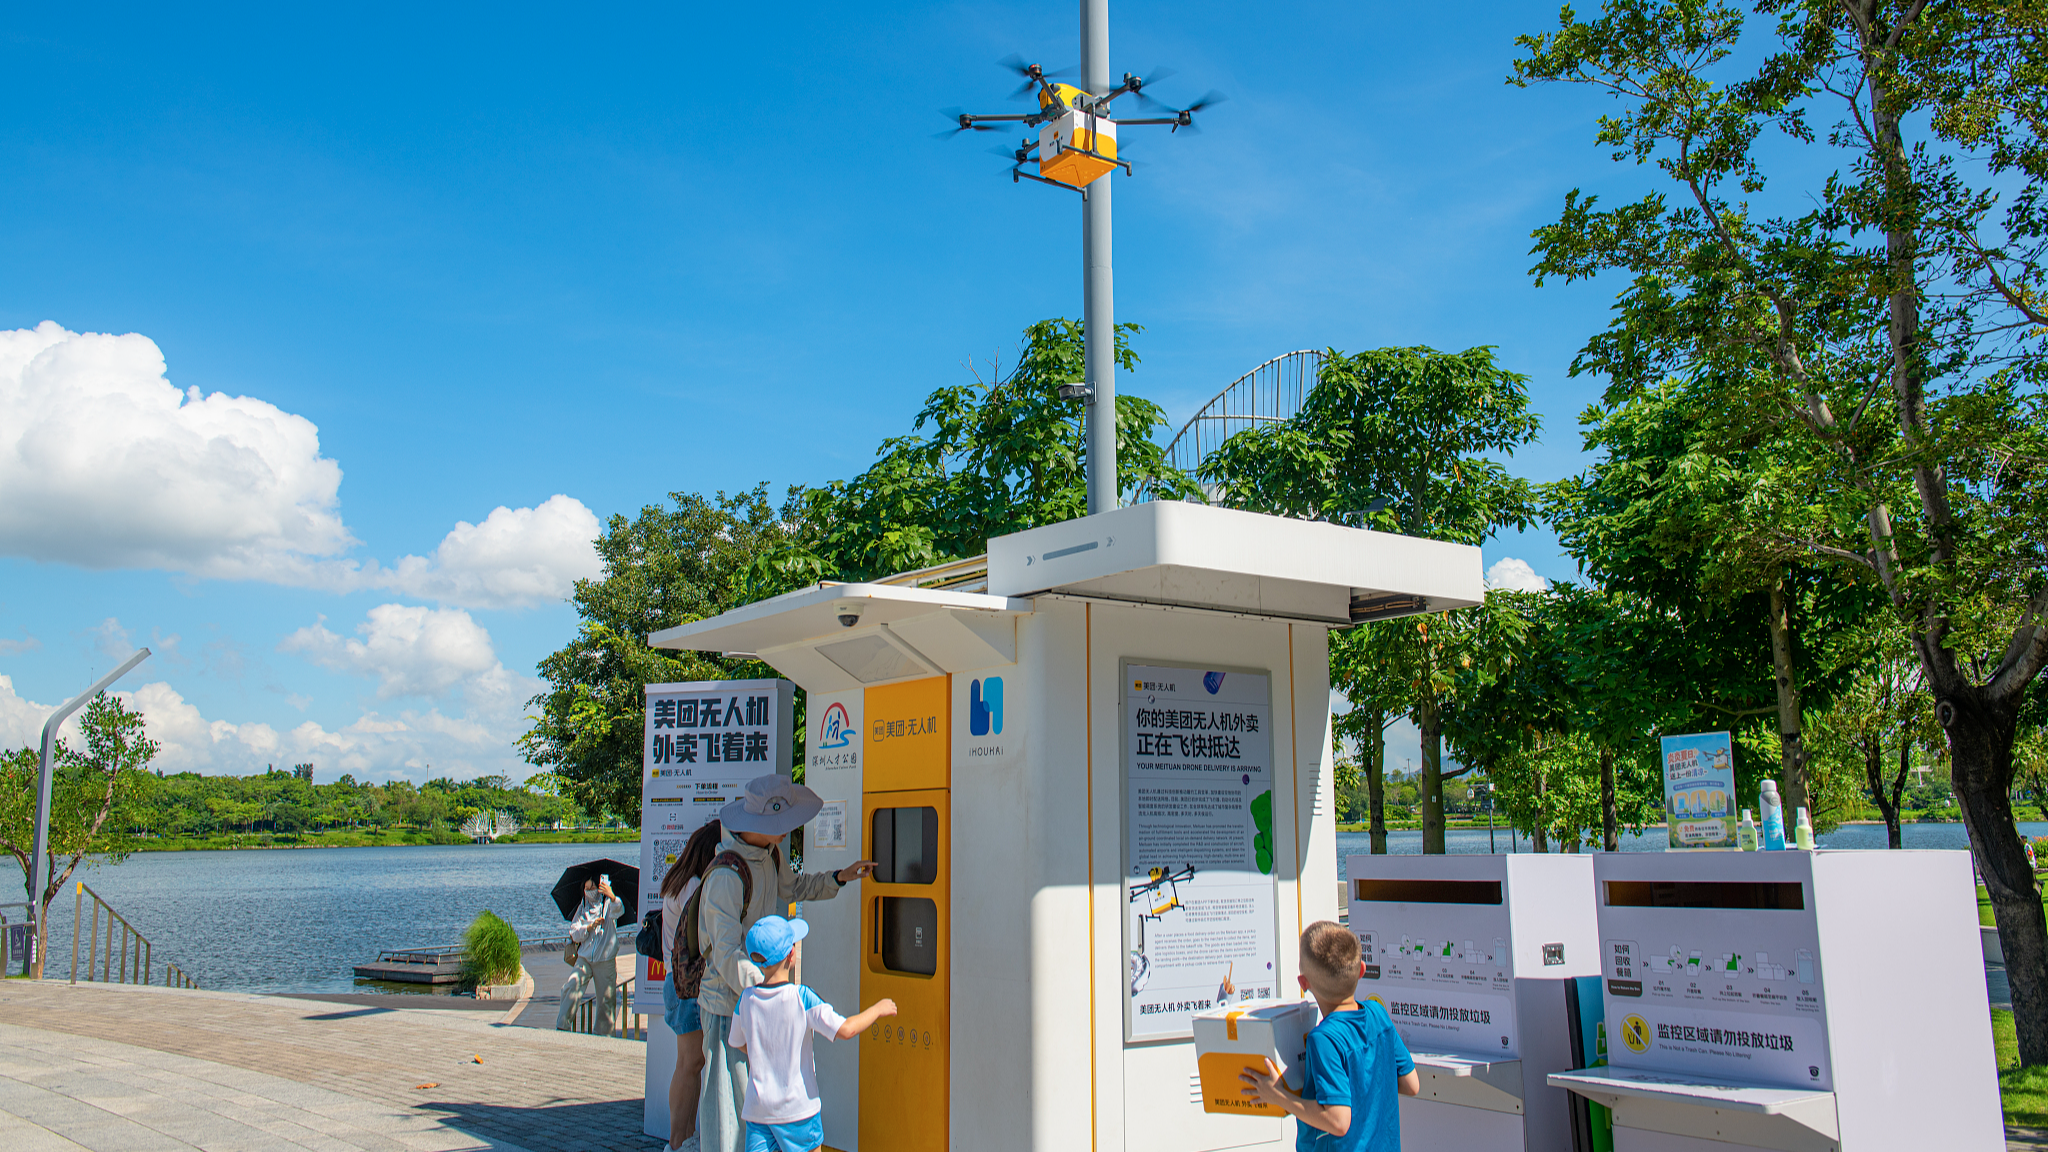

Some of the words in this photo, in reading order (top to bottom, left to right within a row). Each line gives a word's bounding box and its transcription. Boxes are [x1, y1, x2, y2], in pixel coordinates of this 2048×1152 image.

[653, 696, 768, 729] 美团无人机
[1136, 708, 1259, 733] 你的美团无人机外卖
[886, 716, 937, 738] 美团·无人机
[653, 731, 768, 764] 外卖飞着来
[1136, 732, 1241, 759] 正在飞快抵达
[812, 752, 857, 767] 深圳人才公园
[1614, 944, 1630, 954] 如何
[1615, 956, 1631, 966] 回收
[1140, 999, 1175, 1015] 美团无人机
[1176, 998, 1212, 1012] 外卖飞着来
[1391, 1001, 1491, 1025] 监控区域请勿投放垃圾
[1657, 1023, 1794, 1052] 监控区域请勿投放垃圾
